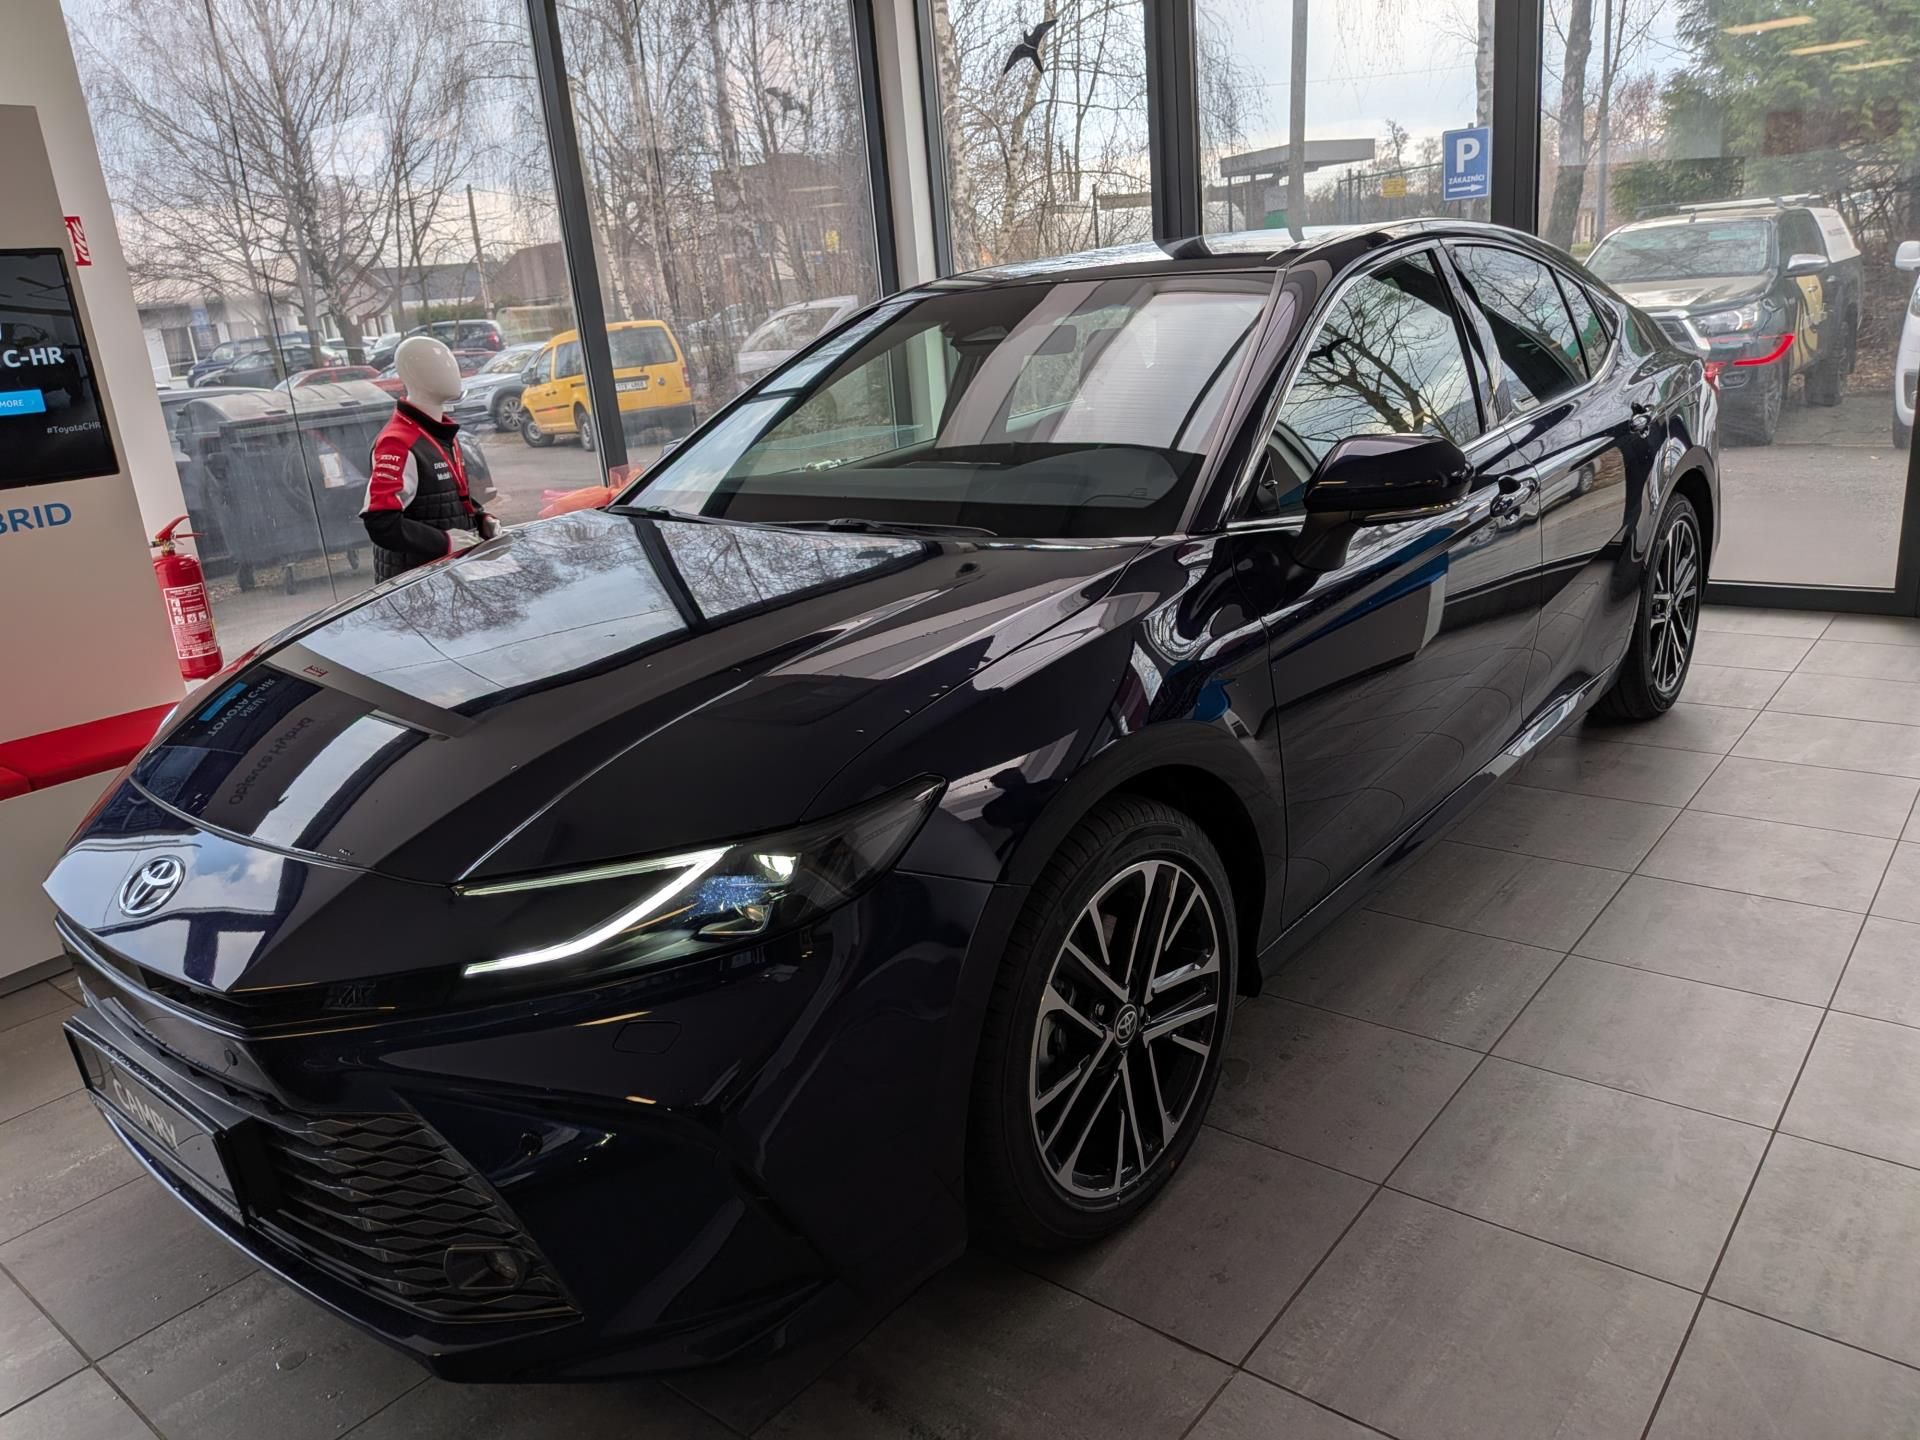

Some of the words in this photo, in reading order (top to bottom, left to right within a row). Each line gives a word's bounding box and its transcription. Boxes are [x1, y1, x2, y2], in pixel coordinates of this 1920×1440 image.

[1456, 138, 1480, 173] P
[3, 346, 65, 368] C-HR
[46, 421, 102, 434] #ToyotaCHR
[113, 1078, 179, 1150] CAMRY
